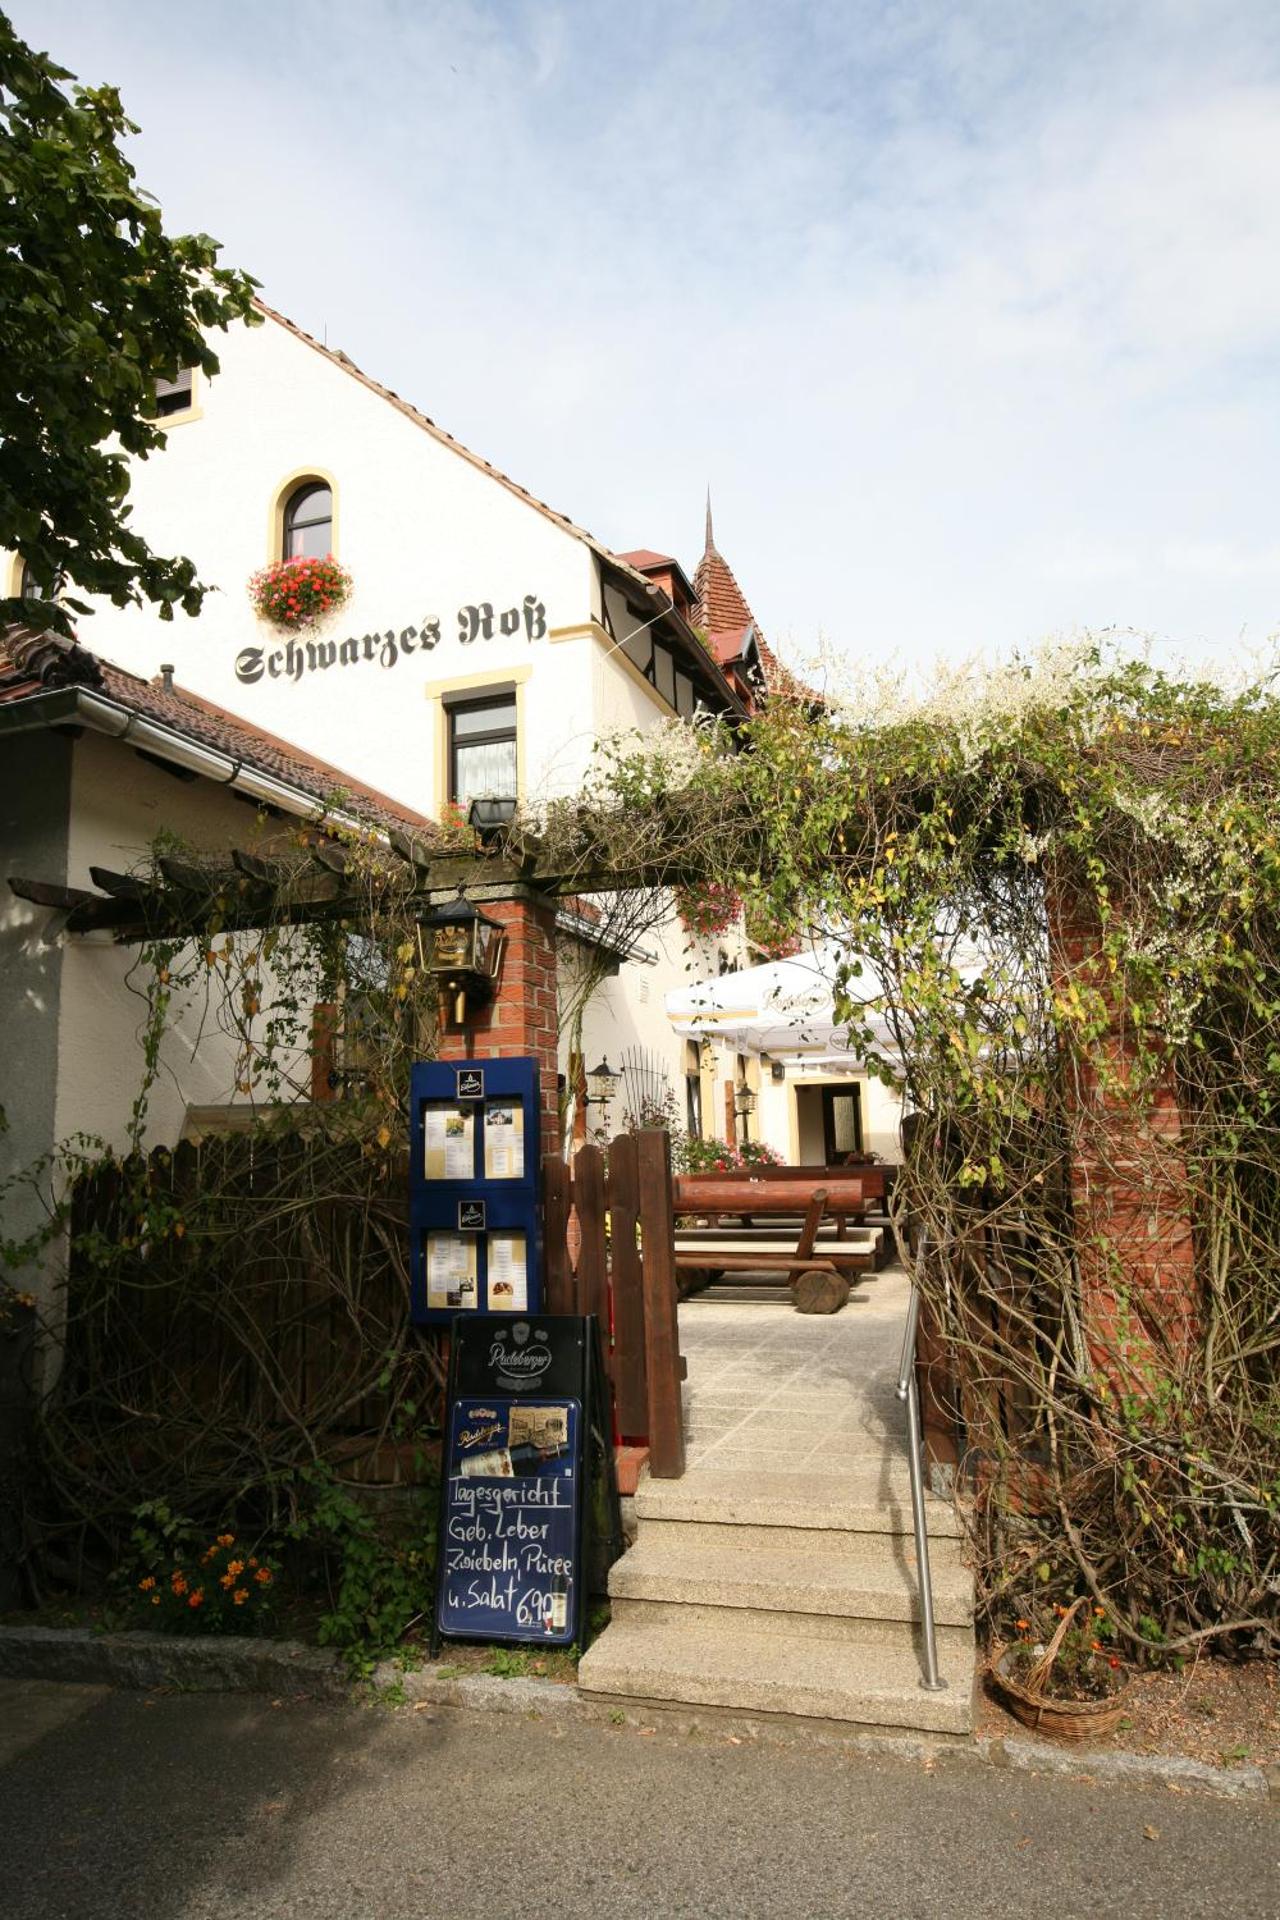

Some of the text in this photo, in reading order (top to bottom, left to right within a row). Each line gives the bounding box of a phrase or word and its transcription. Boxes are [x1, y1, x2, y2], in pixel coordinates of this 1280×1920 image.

[234, 594, 547, 685] Schwarzes Roß
[488, 1342, 551, 1373] Radeberger
[449, 1475, 562, 1516] Tagesgericht
[449, 1510, 549, 1542] Geb. Leber
[521, 1544, 572, 1576] Püree
[467, 1575, 518, 1612] Salat
